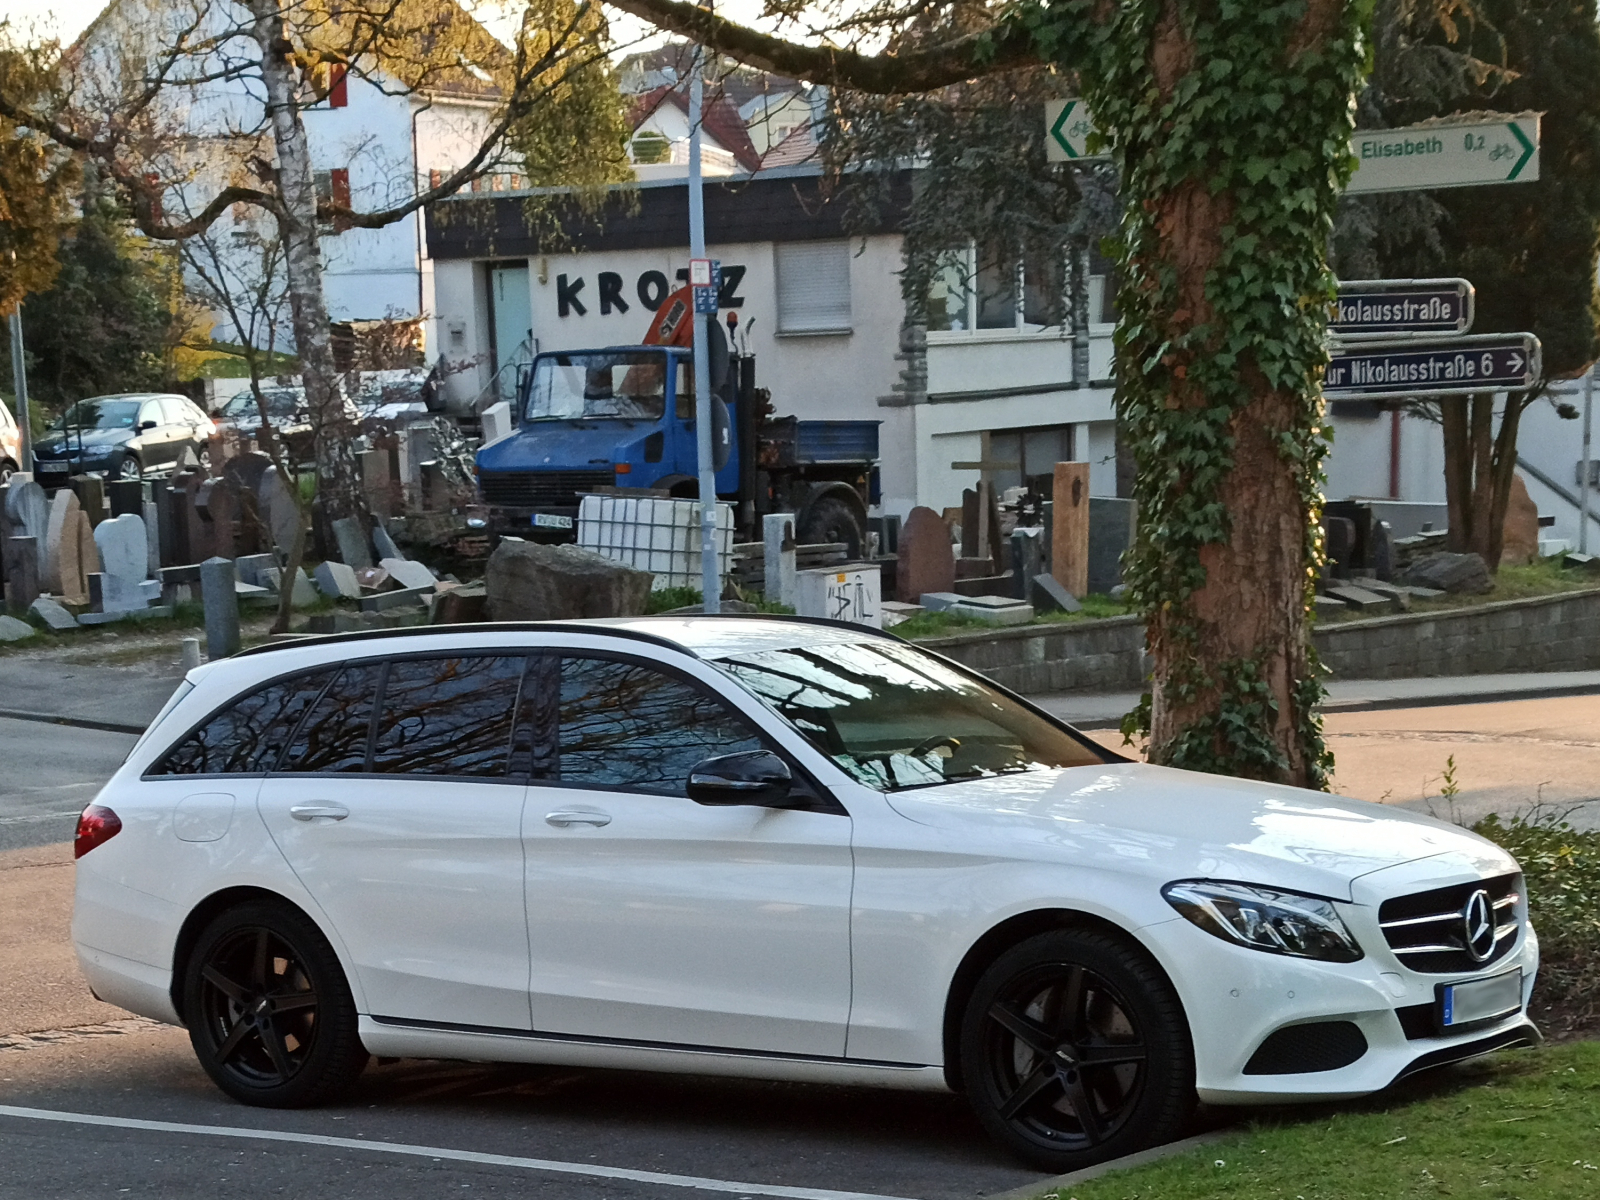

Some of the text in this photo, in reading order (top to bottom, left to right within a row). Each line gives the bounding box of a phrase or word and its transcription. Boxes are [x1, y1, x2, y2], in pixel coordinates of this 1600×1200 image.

[1361, 136, 1443, 159] Elisabeth
[1351, 354, 1476, 384] Nikolausstraße
[1480, 352, 1494, 376] 6
